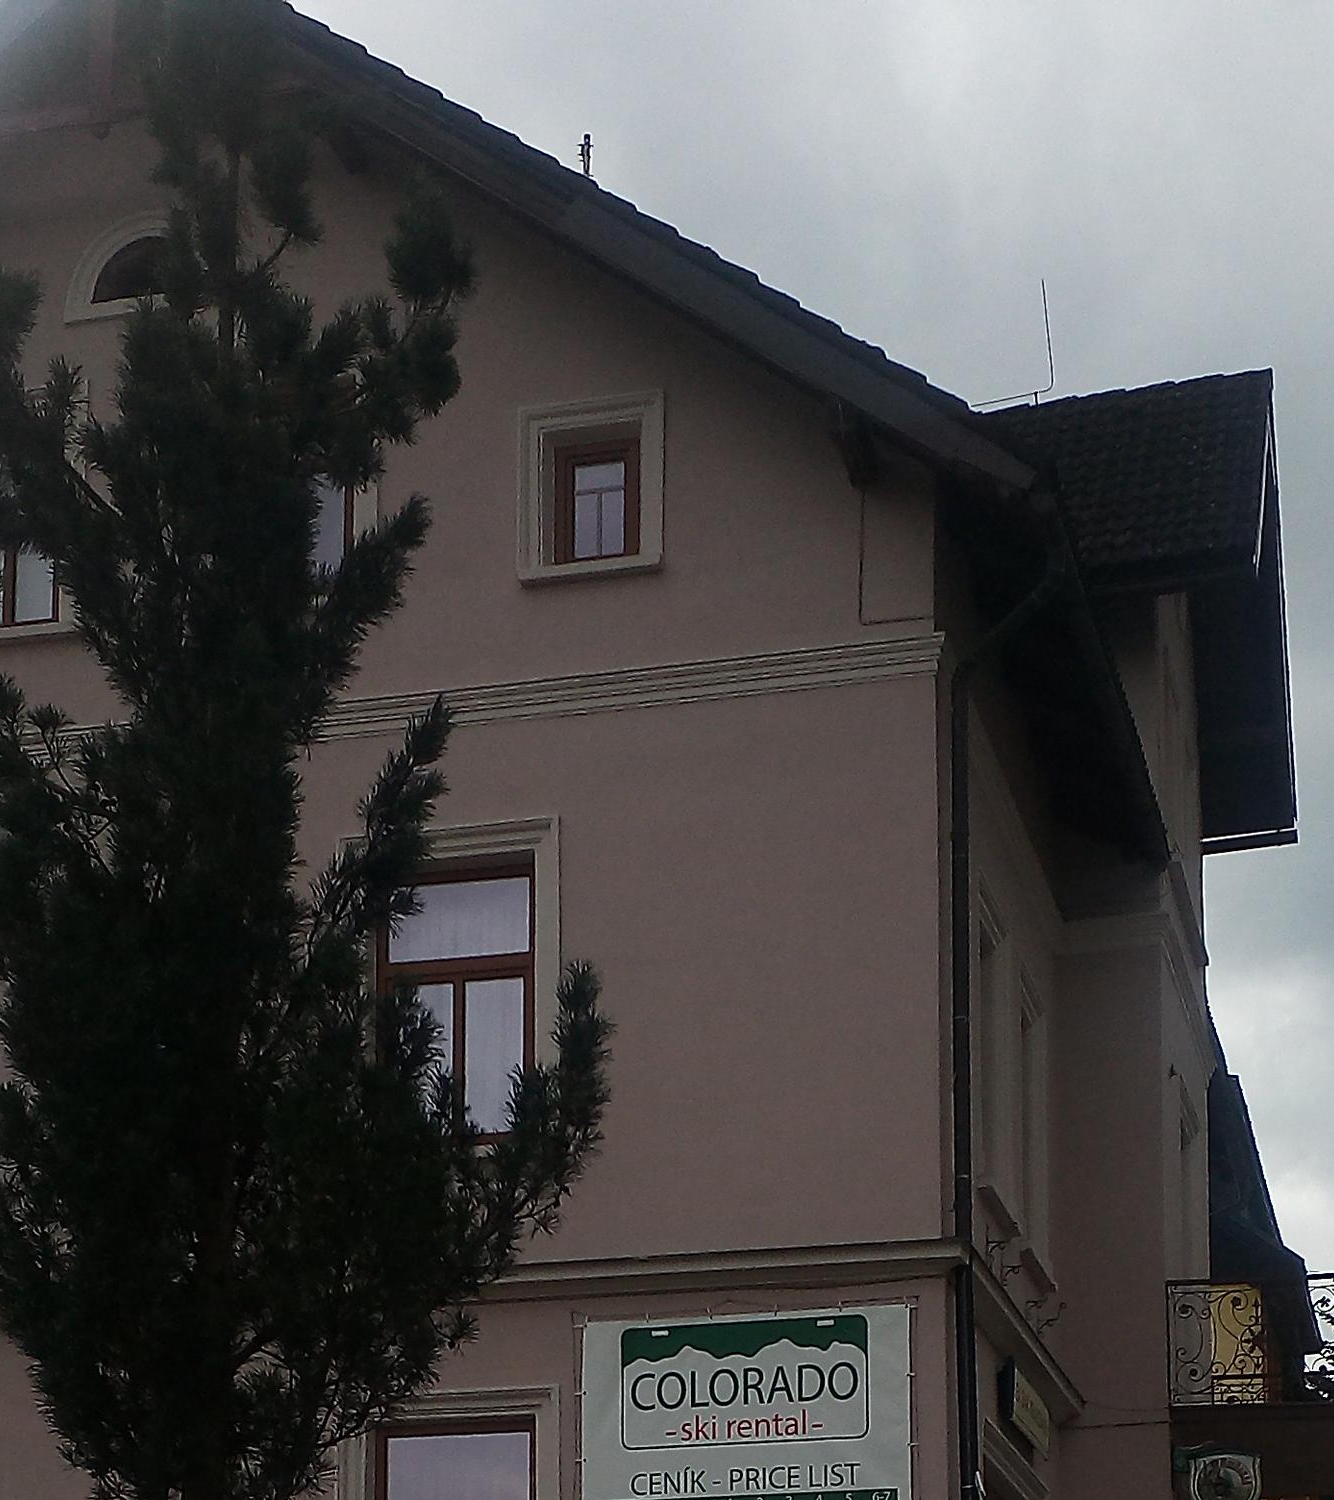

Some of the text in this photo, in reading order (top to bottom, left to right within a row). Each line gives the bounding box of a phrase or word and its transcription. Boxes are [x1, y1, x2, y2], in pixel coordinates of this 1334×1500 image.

[630, 1361, 859, 1411] COLORADO
[630, 1466, 707, 1496] CENÍK
[729, 1466, 801, 1491] PRICE
[808, 1463, 861, 1488] LIST
